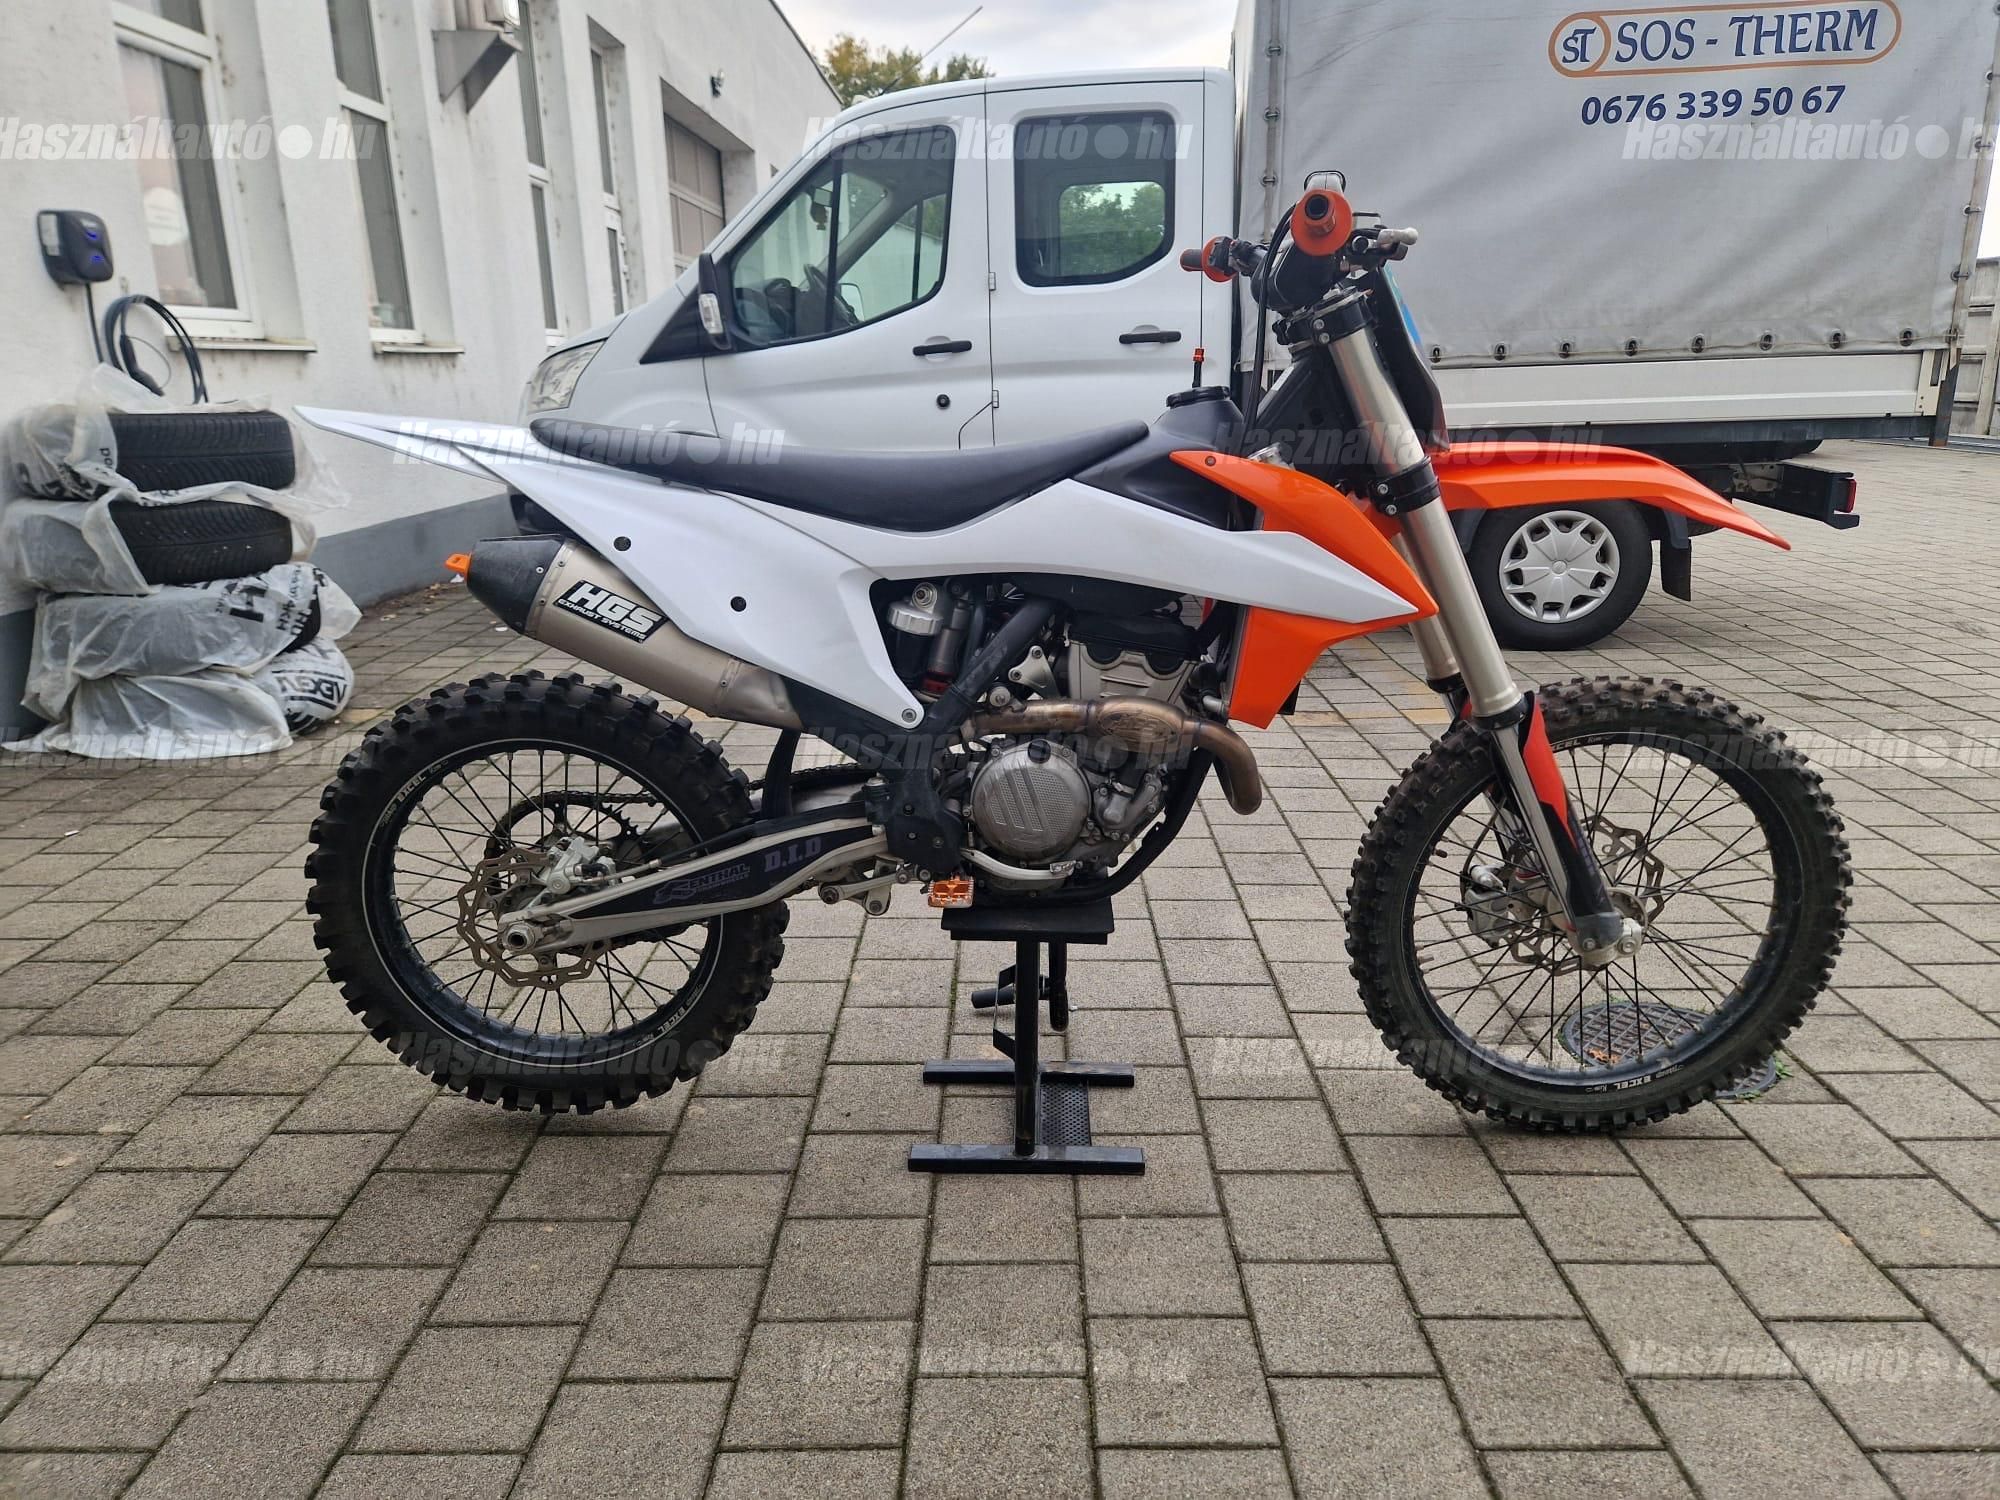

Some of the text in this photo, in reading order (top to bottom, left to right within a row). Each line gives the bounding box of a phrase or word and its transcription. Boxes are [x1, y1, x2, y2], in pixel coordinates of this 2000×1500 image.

[1614, 18, 1696, 62] SOS
[1729, 8, 1878, 57] THERM
[1581, 84, 1846, 125] 0676 339 50 67
[558, 598, 647, 640] EXHAUST SYSTEMS
[567, 582, 662, 633] HGS
[397, 773, 427, 802] EXCEL
[764, 836, 822, 873] D.I.D
[657, 1006, 686, 1033] EXCEL
[1613, 1074, 1653, 1091] EXCEL
